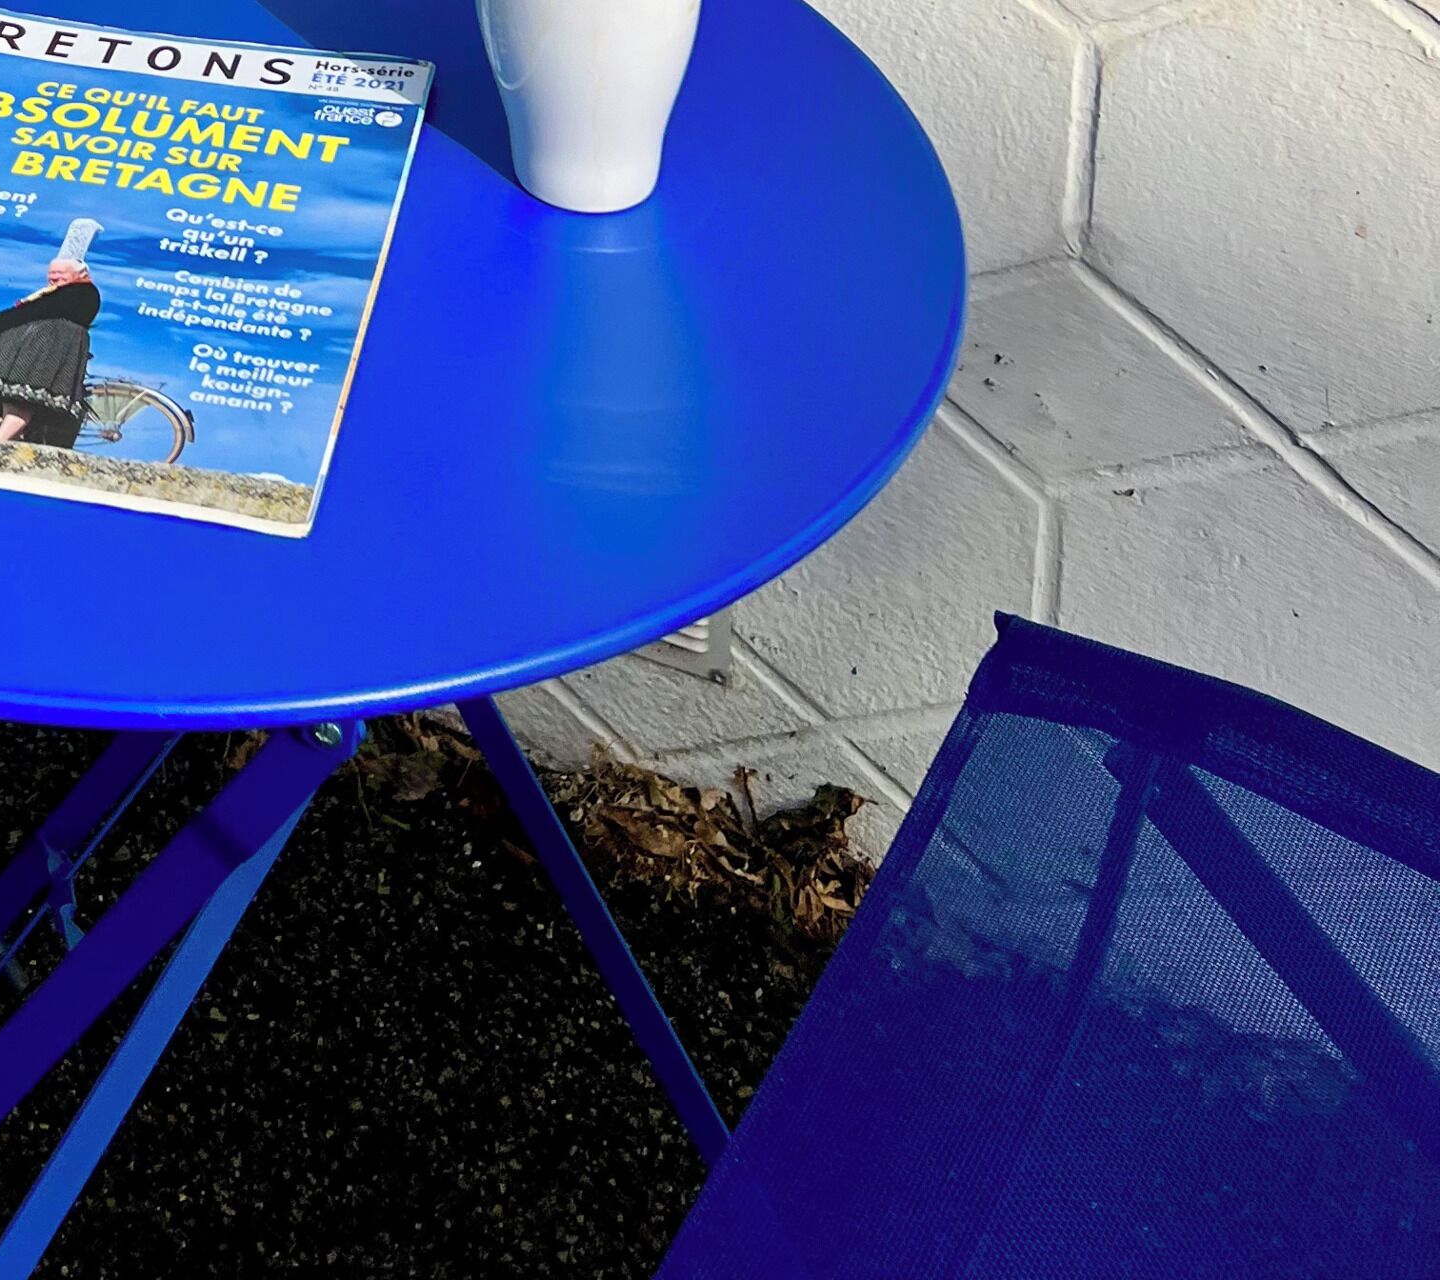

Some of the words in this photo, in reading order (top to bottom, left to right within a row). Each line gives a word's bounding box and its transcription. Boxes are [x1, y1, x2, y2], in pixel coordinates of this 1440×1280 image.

[311, 70, 347, 85] ÉTÉ
[354, 77, 405, 92] 2021
[315, 60, 415, 78] Hors-série
[37, 81, 77, 99] CE
[84, 87, 171, 113] QU'IL
[180, 99, 265, 123] FAUT
[323, 105, 375, 118] ouest
[314, 109, 373, 126] france
[11, 127, 156, 161] SAVOIR
[164, 146, 242, 172] SUR
[11, 150, 301, 212] BRETAGNE
[14, 204, 28, 218] ?
[166, 207, 283, 237] Qu'est-ce
[159, 238, 247, 263] triskell
[254, 250, 269, 265] ?
[182, 228, 255, 248] qu'un
[136, 277, 200, 298] temps
[205, 287, 226, 302] la
[232, 292, 333, 317] Bretagne
[174, 270, 269, 295] Combien
[274, 283, 302, 299] de
[138, 302, 293, 340] indépendante
[299, 327, 312, 342] ?
[170, 297, 247, 319] a-t-elle
[252, 309, 288, 325] été
[189, 356, 211, 373] le
[216, 364, 314, 388] meilleur
[192, 343, 228, 361] Où
[233, 351, 320, 374] trouver
[201, 373, 291, 399] kouign-
[189, 389, 273, 412] amann
[280, 400, 294, 415] ?
